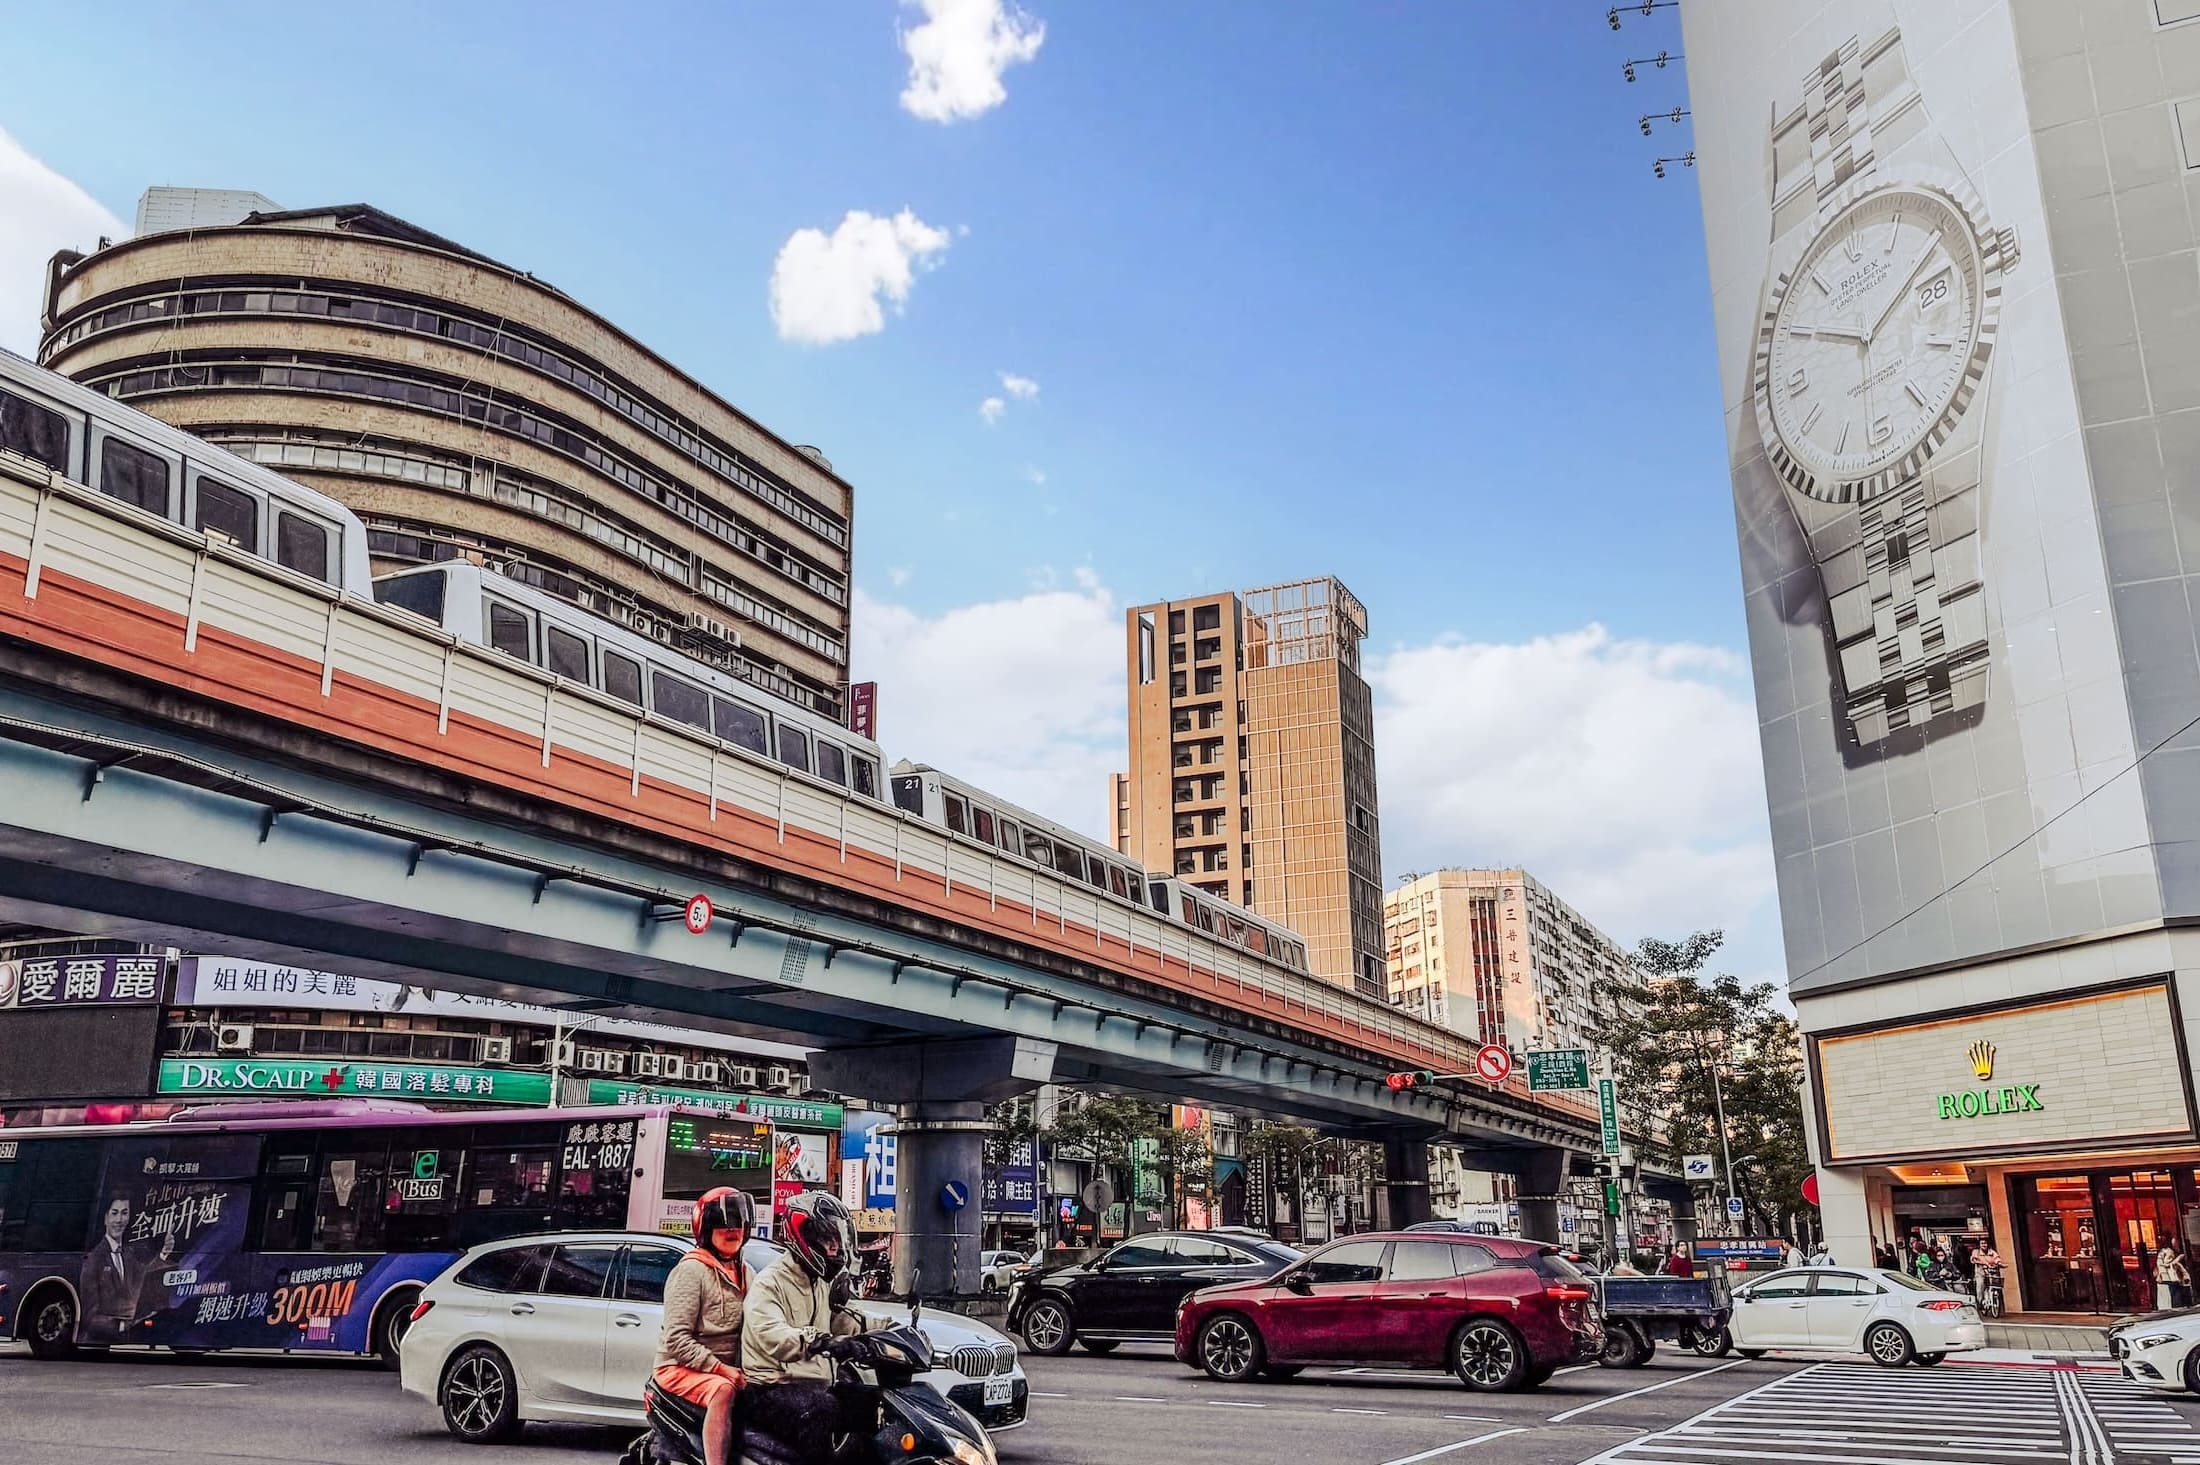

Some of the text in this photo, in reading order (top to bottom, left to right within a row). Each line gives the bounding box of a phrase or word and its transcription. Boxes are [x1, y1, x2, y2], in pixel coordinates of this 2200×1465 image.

[1840, 258, 1880, 291] ROLEX
[1920, 279, 1948, 310] 28
[904, 778, 919, 790] 21
[928, 782, 940, 794] 21
[21, 958, 159, 1002] 愛爾麗
[213, 966, 358, 997] 姐姐的美麗
[355, 1070, 495, 1095] 韓國落髮專科
[1937, 1083, 2044, 1120] ROLEX
[416, 1152, 436, 1179] e
[562, 1144, 633, 1170] EAL-1887
[864, 1123, 897, 1197] 租
[406, 1180, 439, 1198] Bus
[128, 1192, 228, 1243] 全面升速
[194, 1292, 268, 1325] 網速升級
[266, 1279, 357, 1326] 300M
